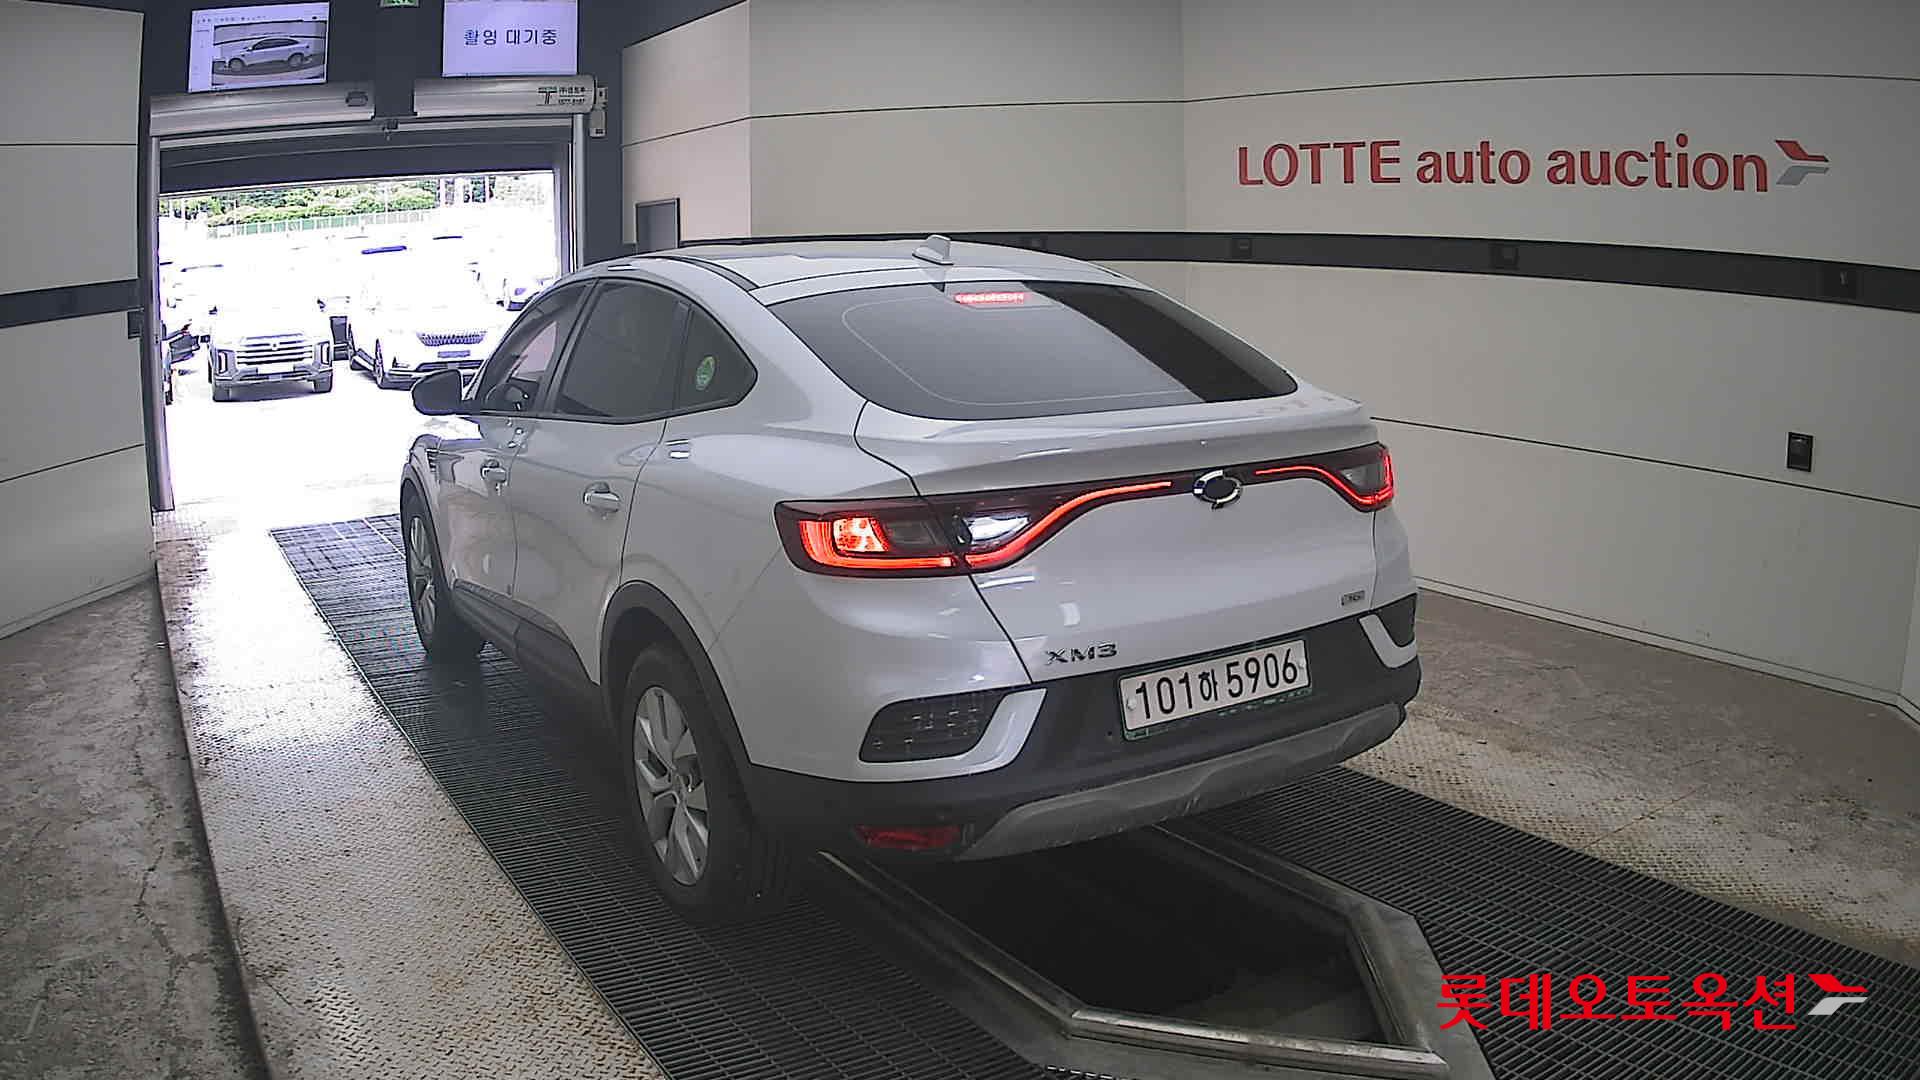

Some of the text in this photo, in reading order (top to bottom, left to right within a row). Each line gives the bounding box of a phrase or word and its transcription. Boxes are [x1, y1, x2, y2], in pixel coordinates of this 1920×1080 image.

[505, 28, 558, 46] 대기중
[1237, 132, 1769, 193] LOTTE auto auction
[1047, 642, 1118, 666] XM3
